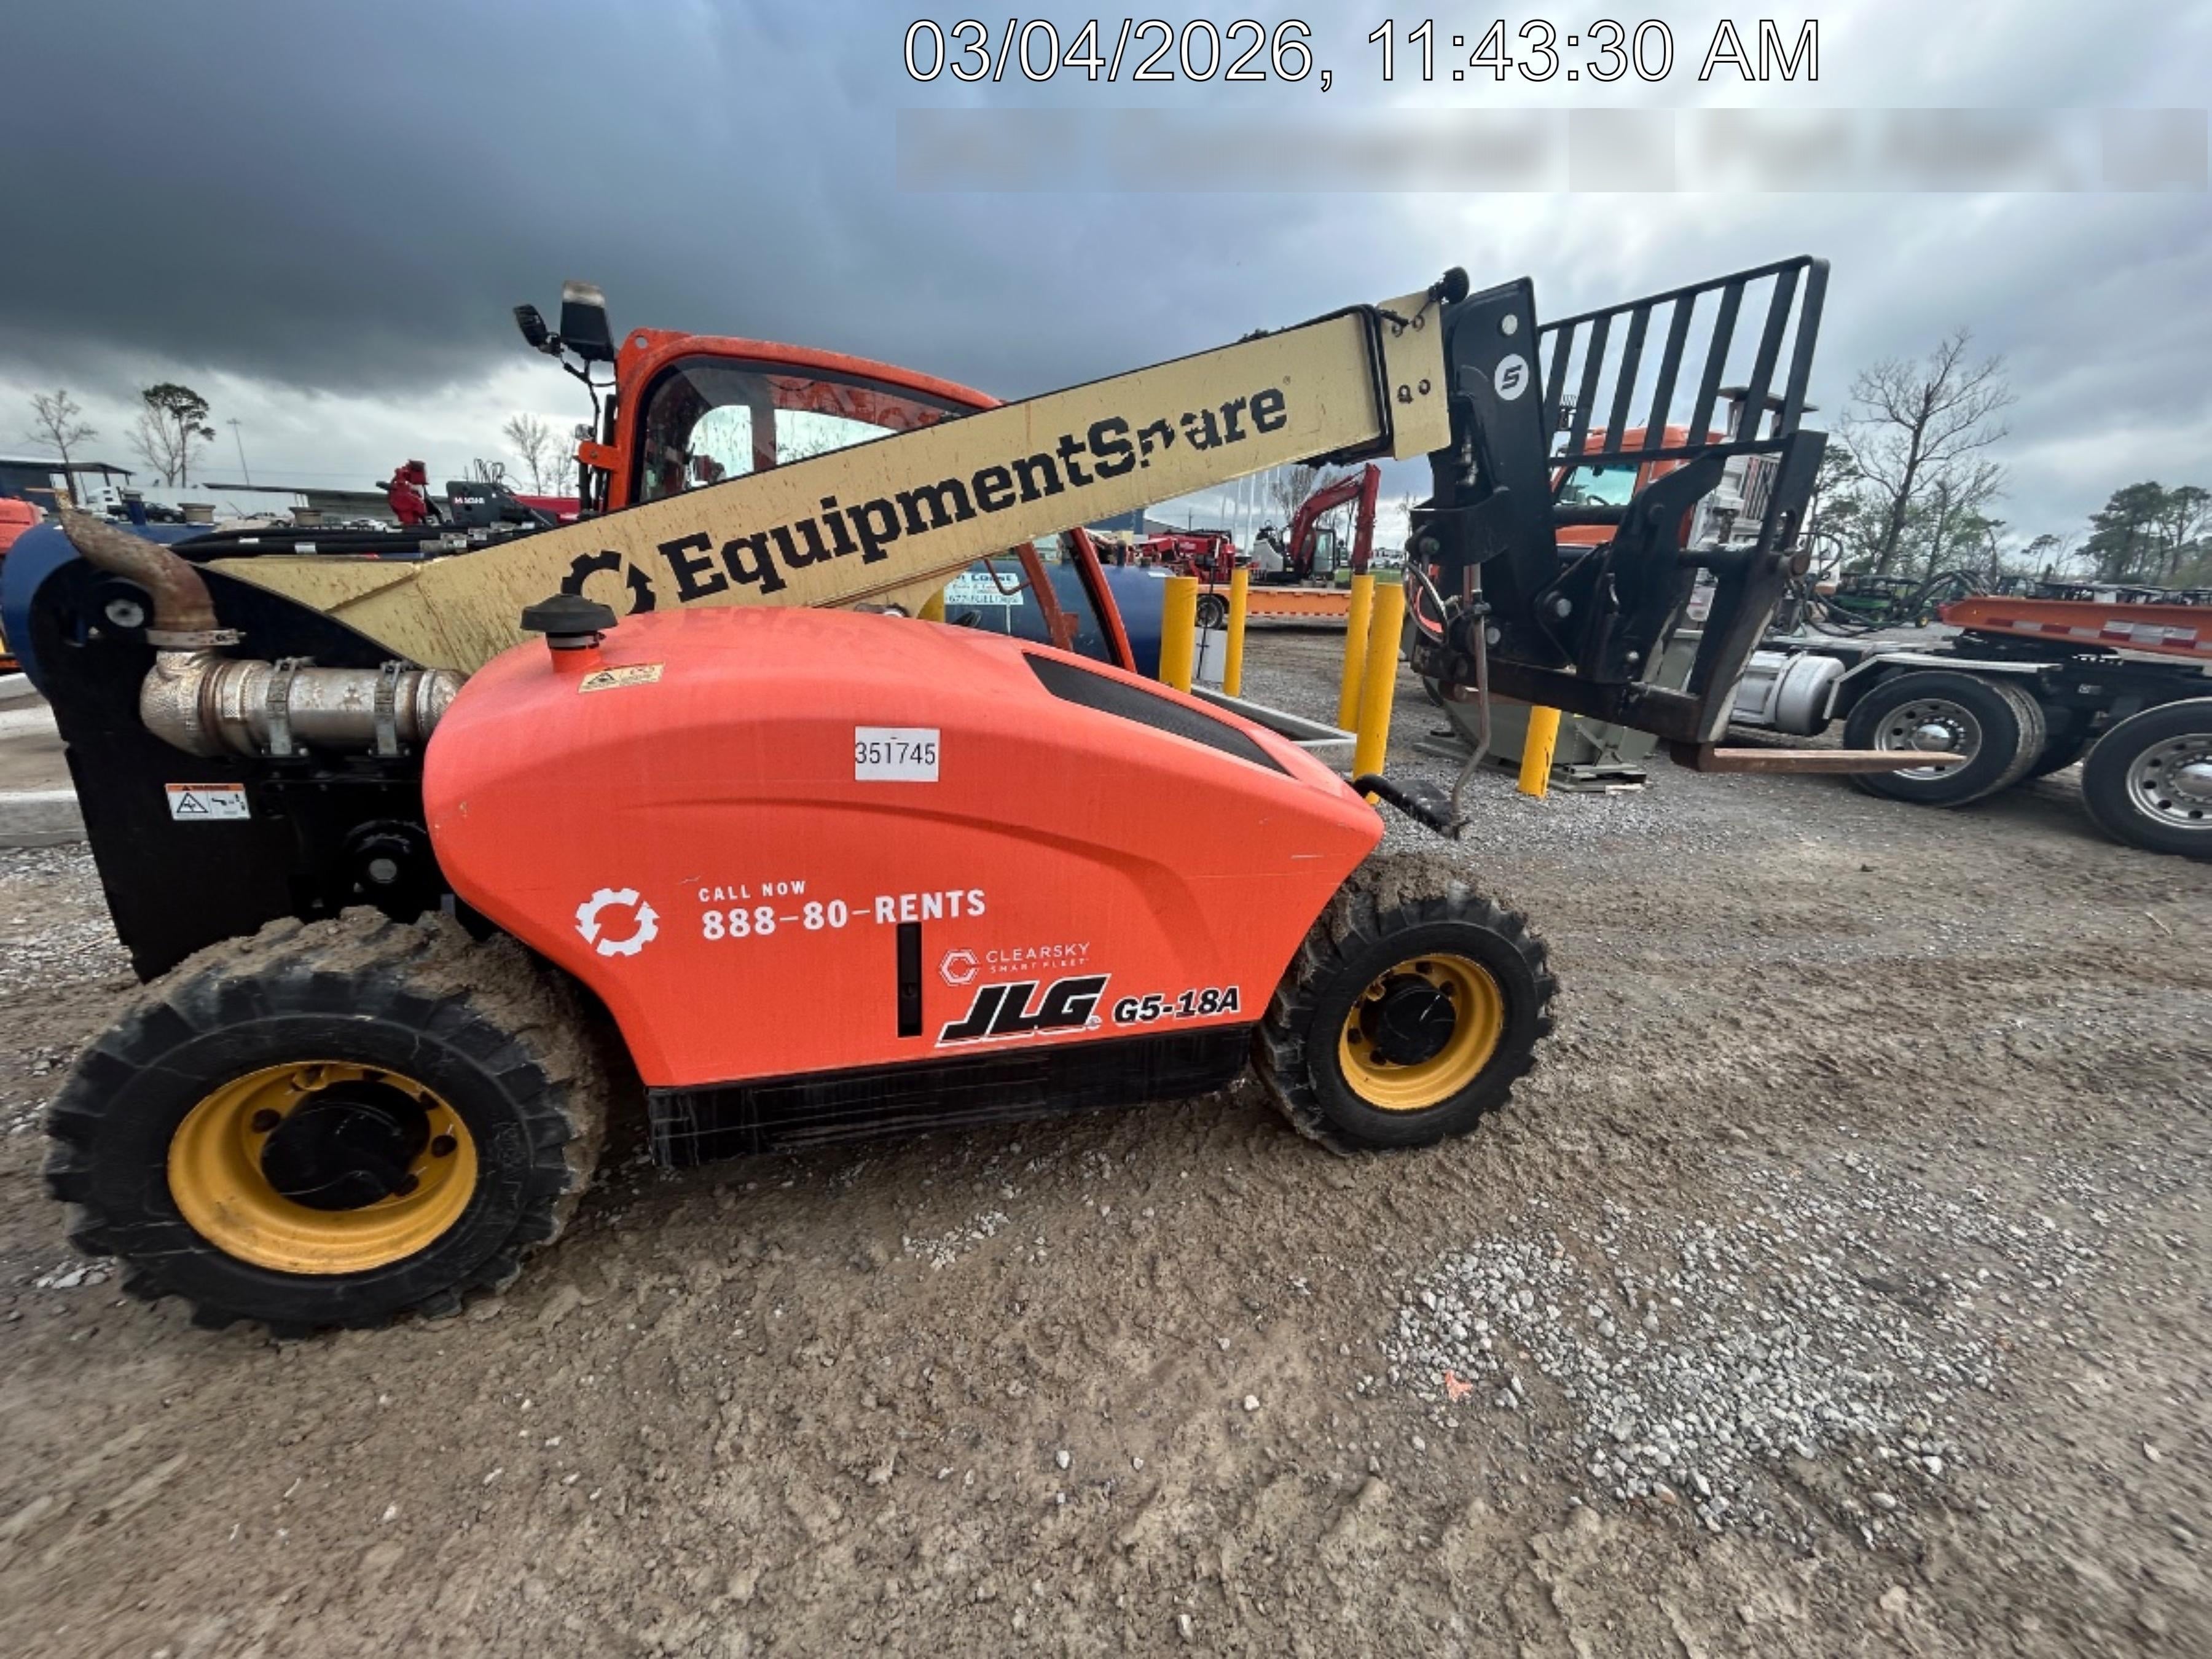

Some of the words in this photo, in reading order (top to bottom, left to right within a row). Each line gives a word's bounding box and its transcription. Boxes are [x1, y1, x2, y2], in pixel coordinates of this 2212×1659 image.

[855, 740, 935, 765] 351745
[698, 885, 750, 902] CALL
[763, 880, 806, 896] NOW
[702, 888, 986, 941] 888-80-RENTS
[986, 941, 1091, 963] CLEARSKY
[989, 962, 1037, 974] SMART
[935, 973, 1111, 1047] JLG
[1113, 986, 1241, 1027] G5-18A
